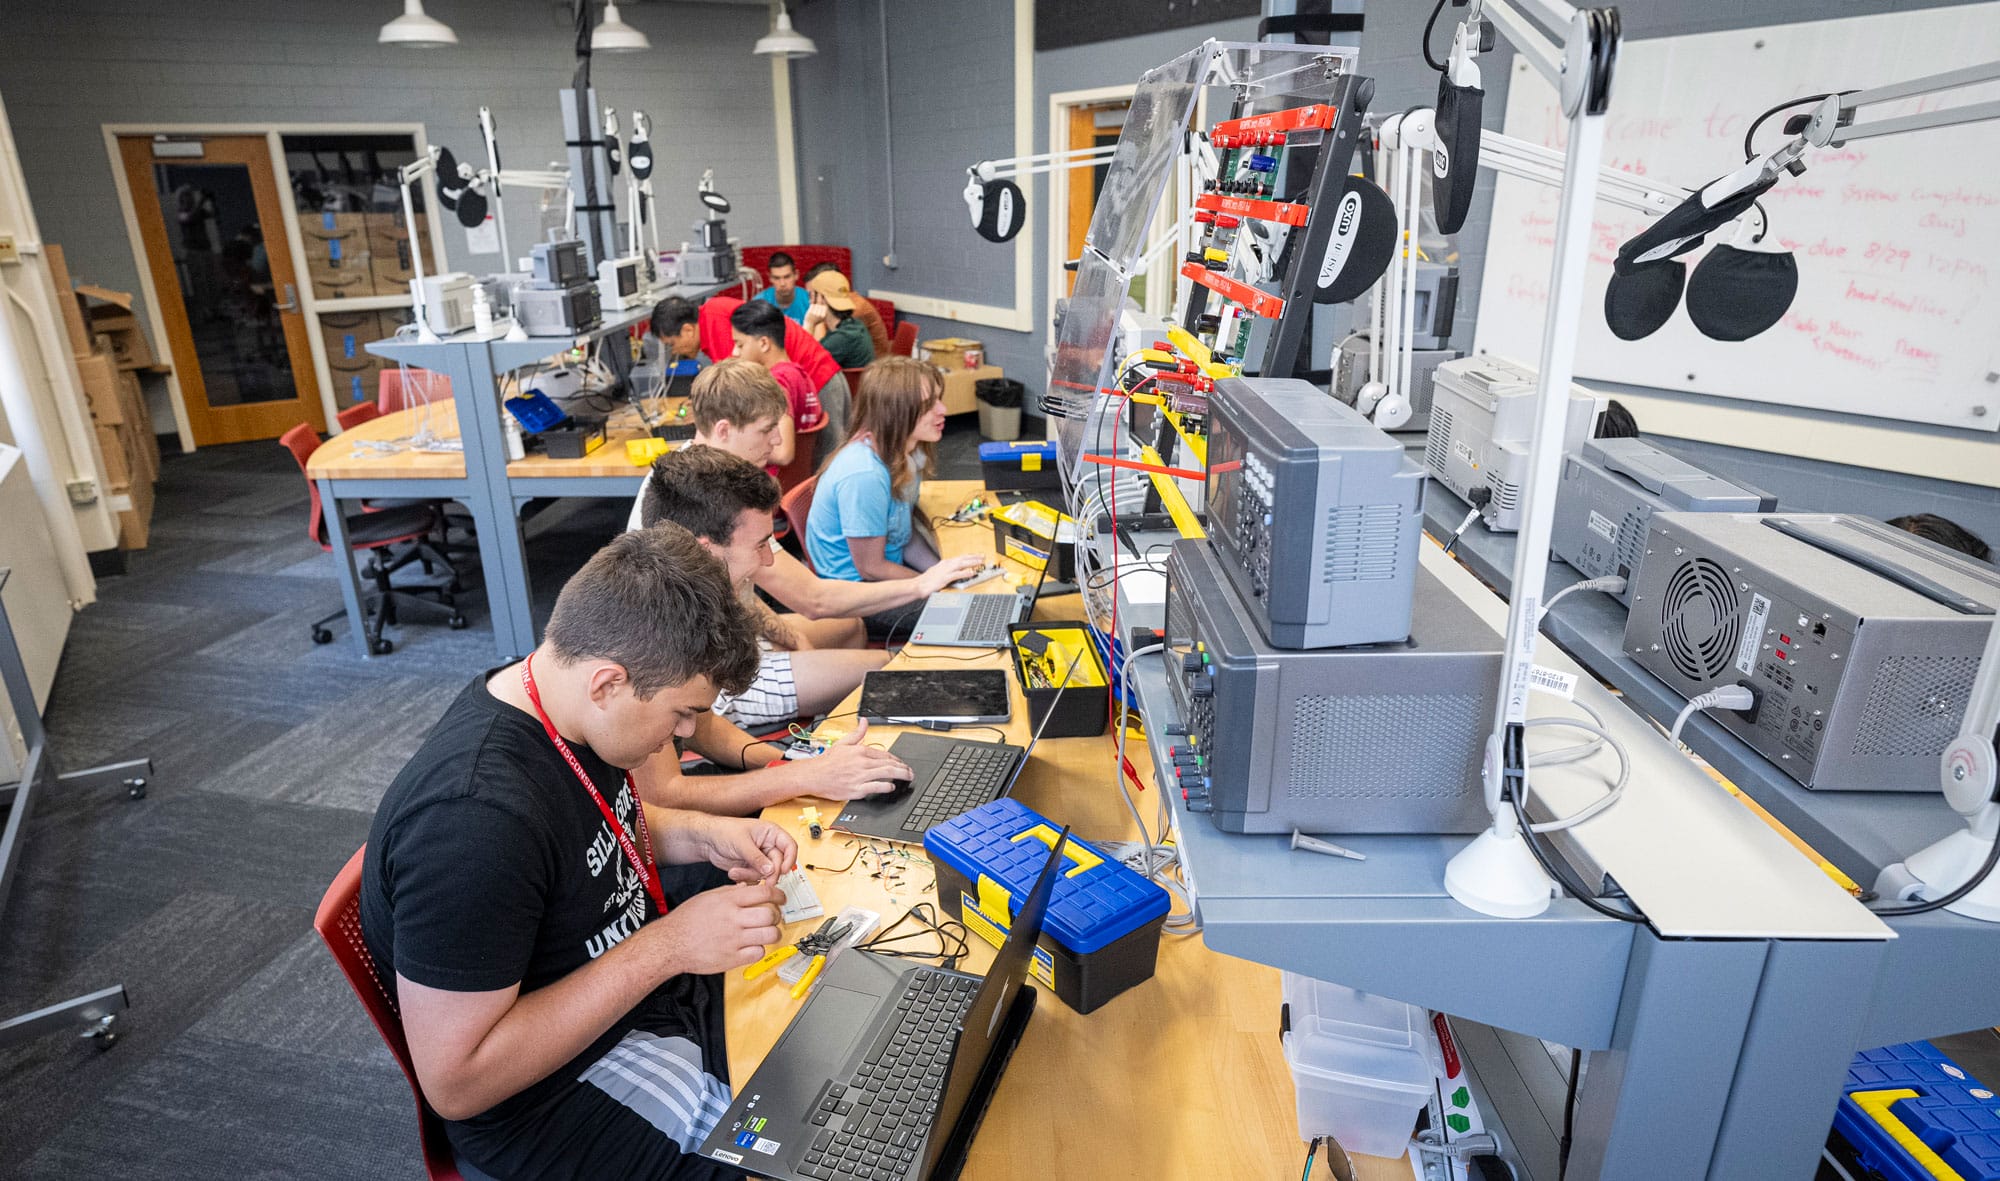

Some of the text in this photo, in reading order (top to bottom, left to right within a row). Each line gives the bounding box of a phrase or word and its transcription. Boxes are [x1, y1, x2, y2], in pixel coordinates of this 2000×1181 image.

[1339, 199, 1356, 235] LUXO
[1863, 241, 1912, 272] 8/29
[553, 734, 597, 796] WISCONSIN
[586, 820, 617, 877] SILL
[619, 832, 650, 882] WISCONSIN
[714, 1151, 740, 1162] Lenovo
